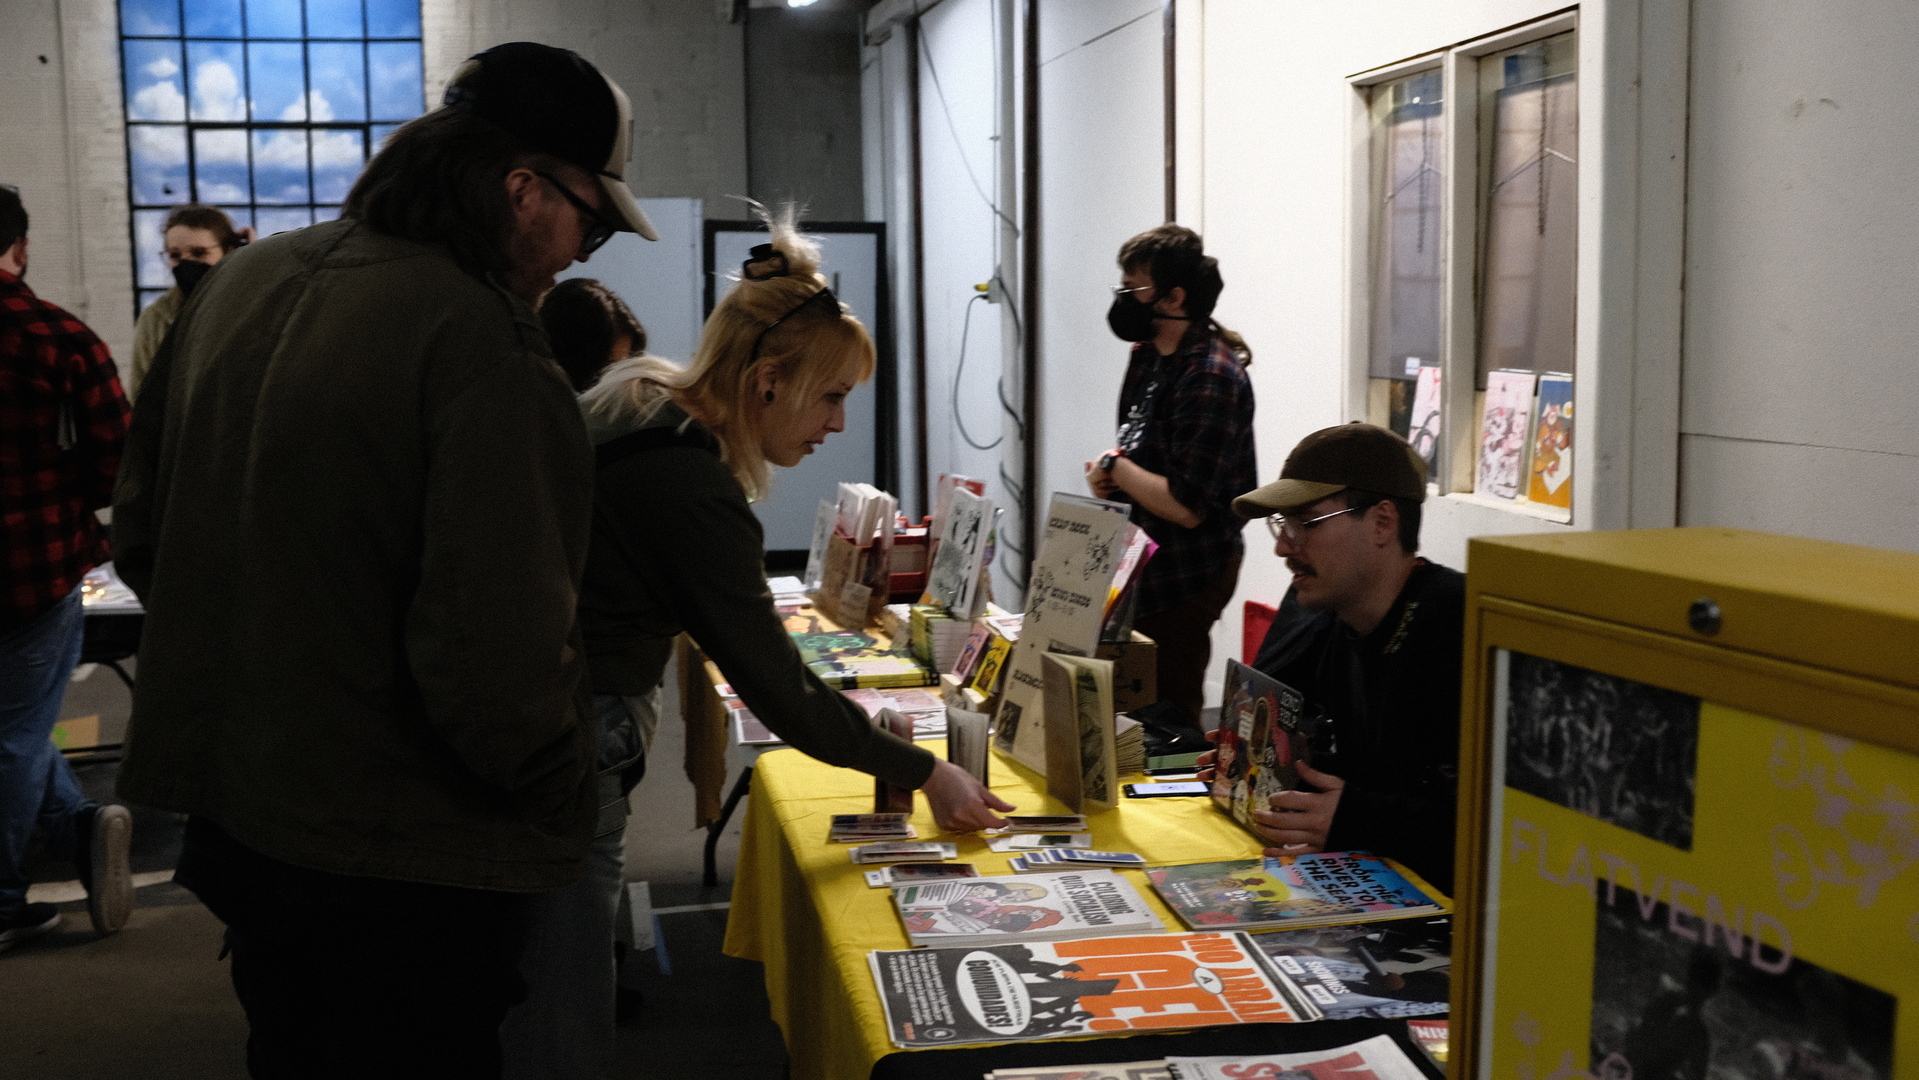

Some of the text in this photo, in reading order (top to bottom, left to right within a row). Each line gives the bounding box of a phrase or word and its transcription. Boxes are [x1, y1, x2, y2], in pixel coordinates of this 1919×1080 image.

[1300, 859, 1332, 881] THE
[1318, 858, 1377, 901] RIVER TO
[1339, 856, 1398, 900] FROM THE
[1058, 875, 1113, 926] OUR SOCIALISM
[1089, 881, 1136, 915] COLORING
[1510, 818, 1794, 975] FLATVEND
[965, 960, 1014, 1027] COMUNIDADES!
[1053, 934, 1243, 1031] ICE!
[1305, 961, 1351, 994] SHOWINGS
